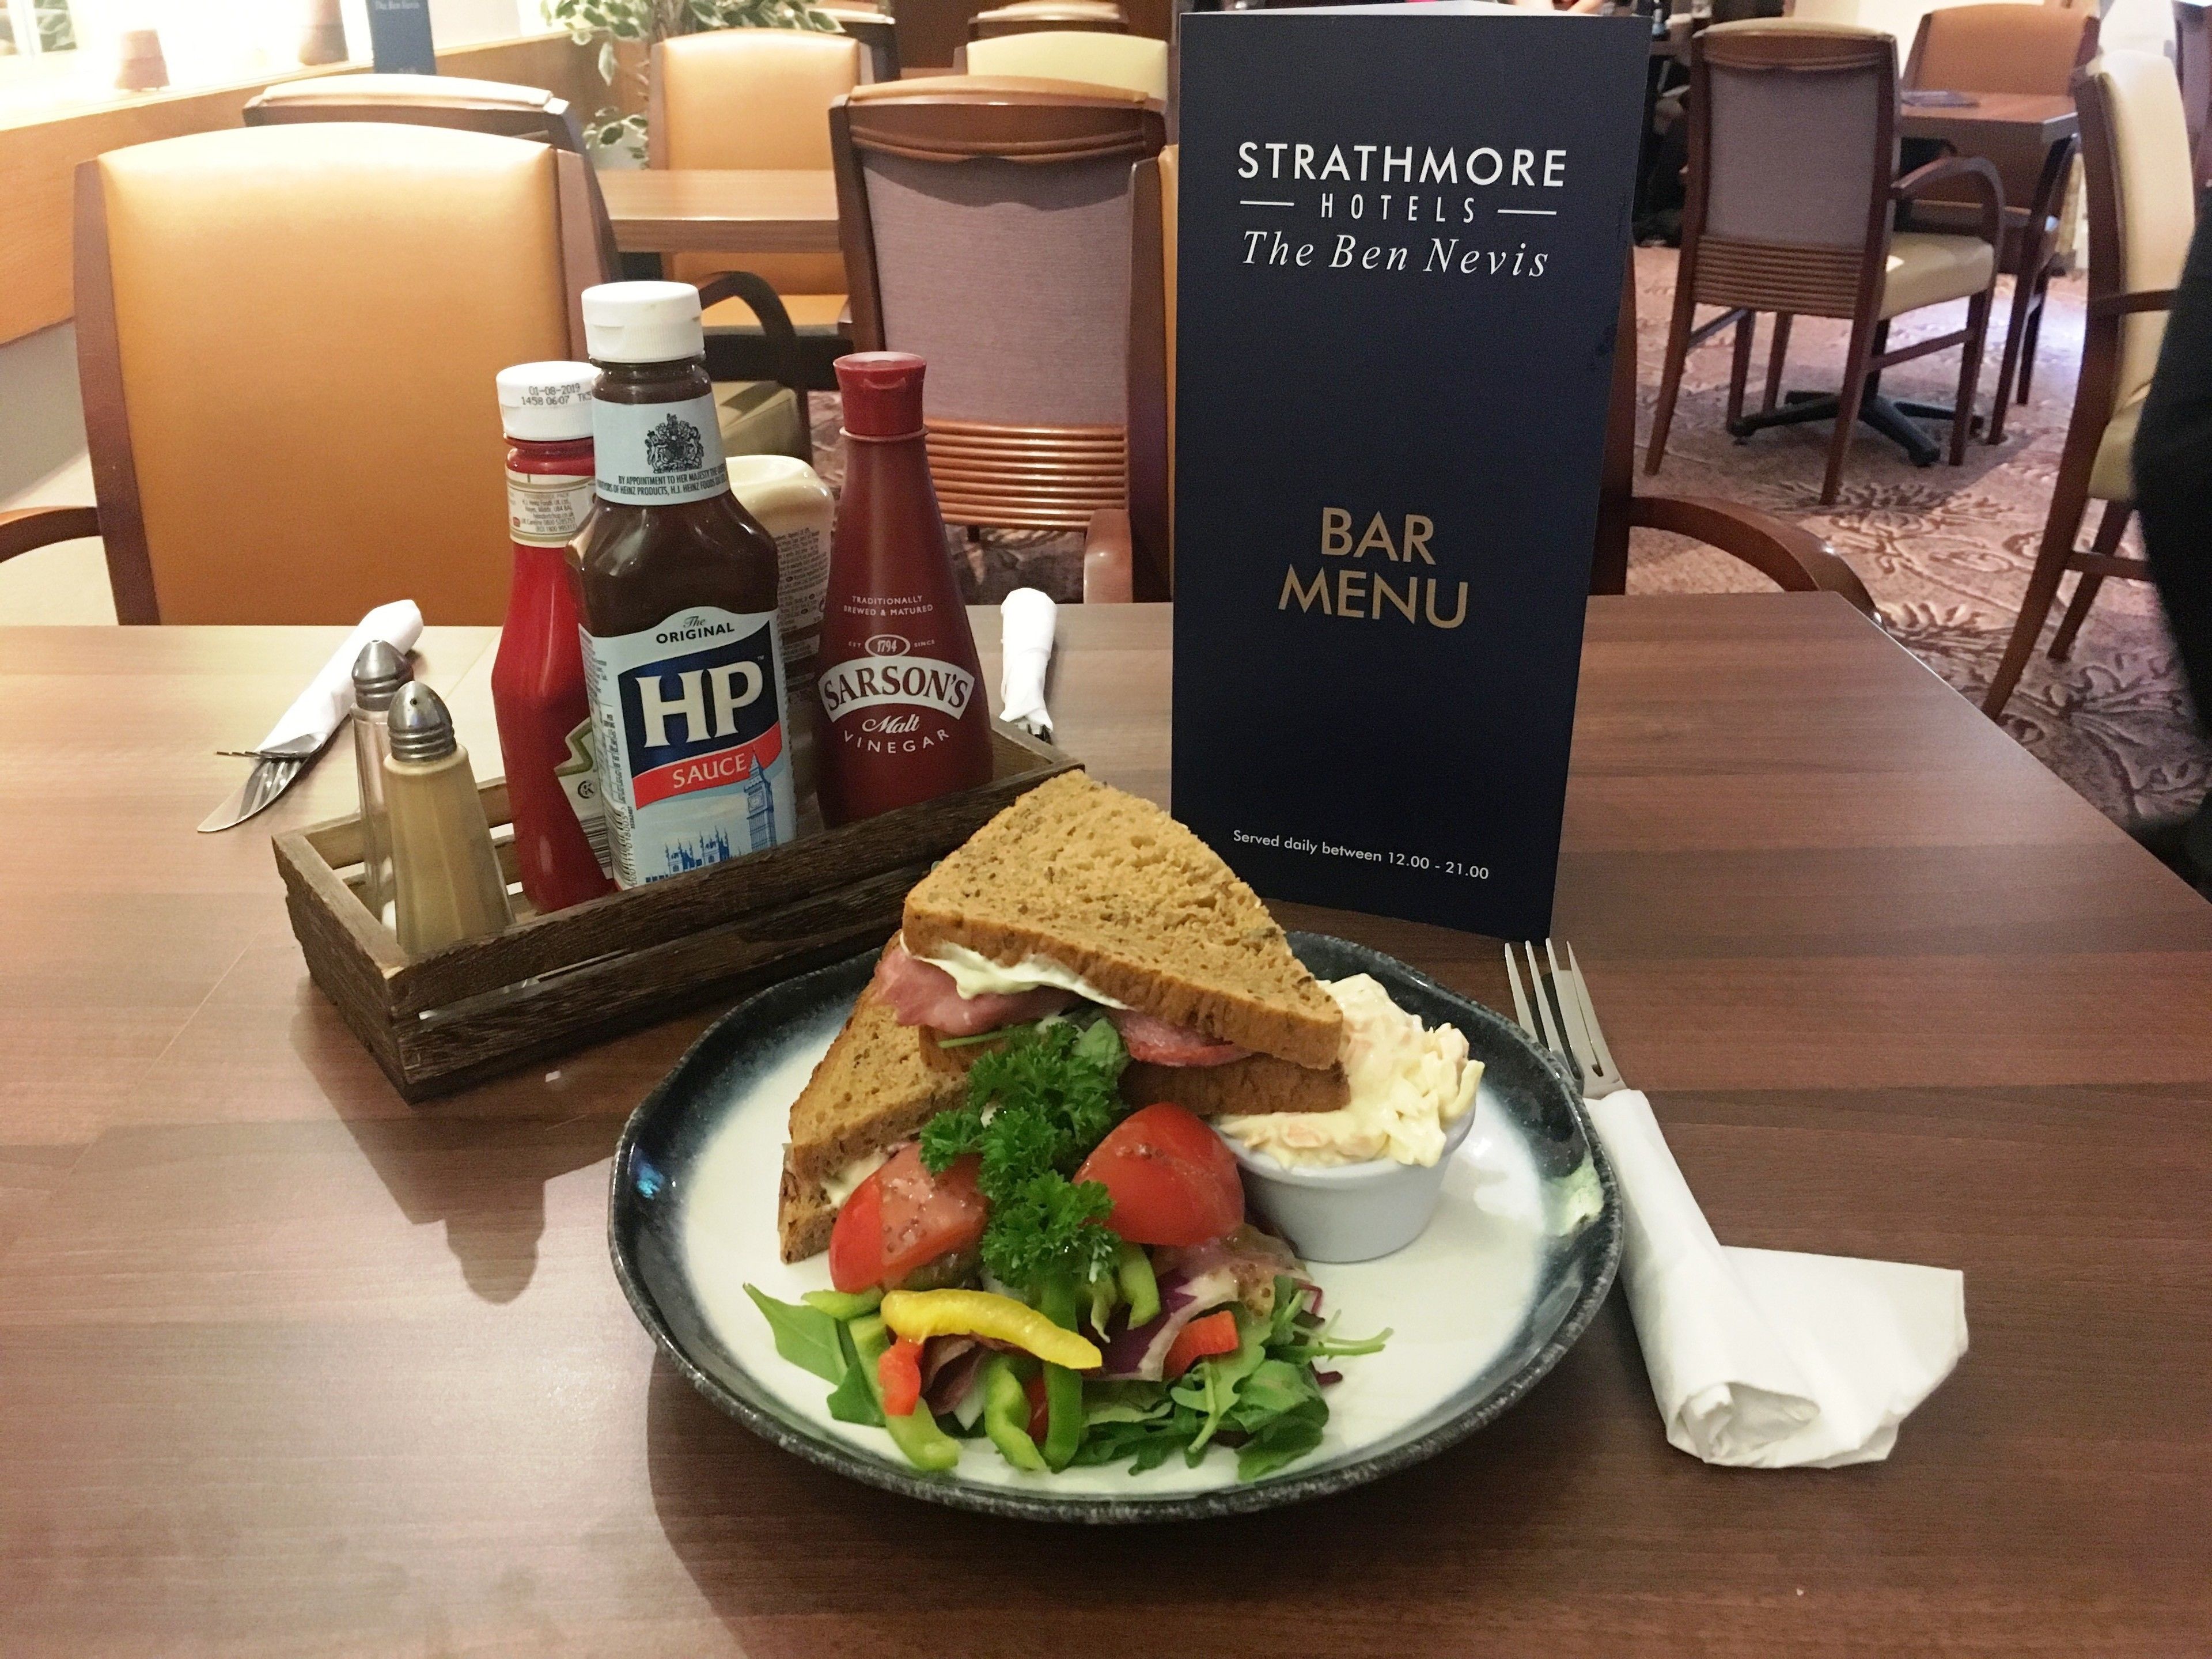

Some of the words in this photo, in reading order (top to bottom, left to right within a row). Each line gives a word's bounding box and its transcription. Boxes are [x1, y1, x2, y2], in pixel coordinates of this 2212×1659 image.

[1238, 142, 1566, 187] STRATHMORE
[1321, 193, 1475, 224] HOTELS
[1243, 230, 1314, 267] The
[1329, 234, 1408, 271] Ben
[1423, 237, 1549, 277] Nevis
[529, 383, 581, 395] 01-08-2019
[521, 396, 543, 405] 1458
[626, 476, 666, 485] APPOINTMENT
[667, 475, 675, 484] TO
[676, 474, 688, 483] HER
[688, 469, 709, 481] MAJESTY
[620, 486, 636, 495] HEINZ
[637, 486, 669, 496] PRODUCTS,
[683, 482, 699, 493] HEINZ
[1321, 507, 1437, 565] BAR
[852, 595, 922, 605] TRADITIONALLY
[1278, 563, 1468, 629] MENU
[844, 605, 876, 616] BREWED
[891, 604, 933, 616] MATURED
[656, 623, 735, 643] ORIGINAL
[683, 616, 706, 628] The
[877, 639, 897, 652] 1794
[914, 639, 935, 647] SINCE
[824, 666, 968, 712] SARSON'S
[635, 661, 763, 748] HP
[862, 714, 920, 734] Malt
[843, 729, 949, 753] VINEGAR
[673, 753, 747, 789] SAUCE
[1233, 830, 1279, 847] Served
[1284, 837, 1317, 855] daily
[1322, 842, 1382, 862] between
[1388, 852, 1430, 869] 12.00
[1445, 861, 1489, 880] 21.00
